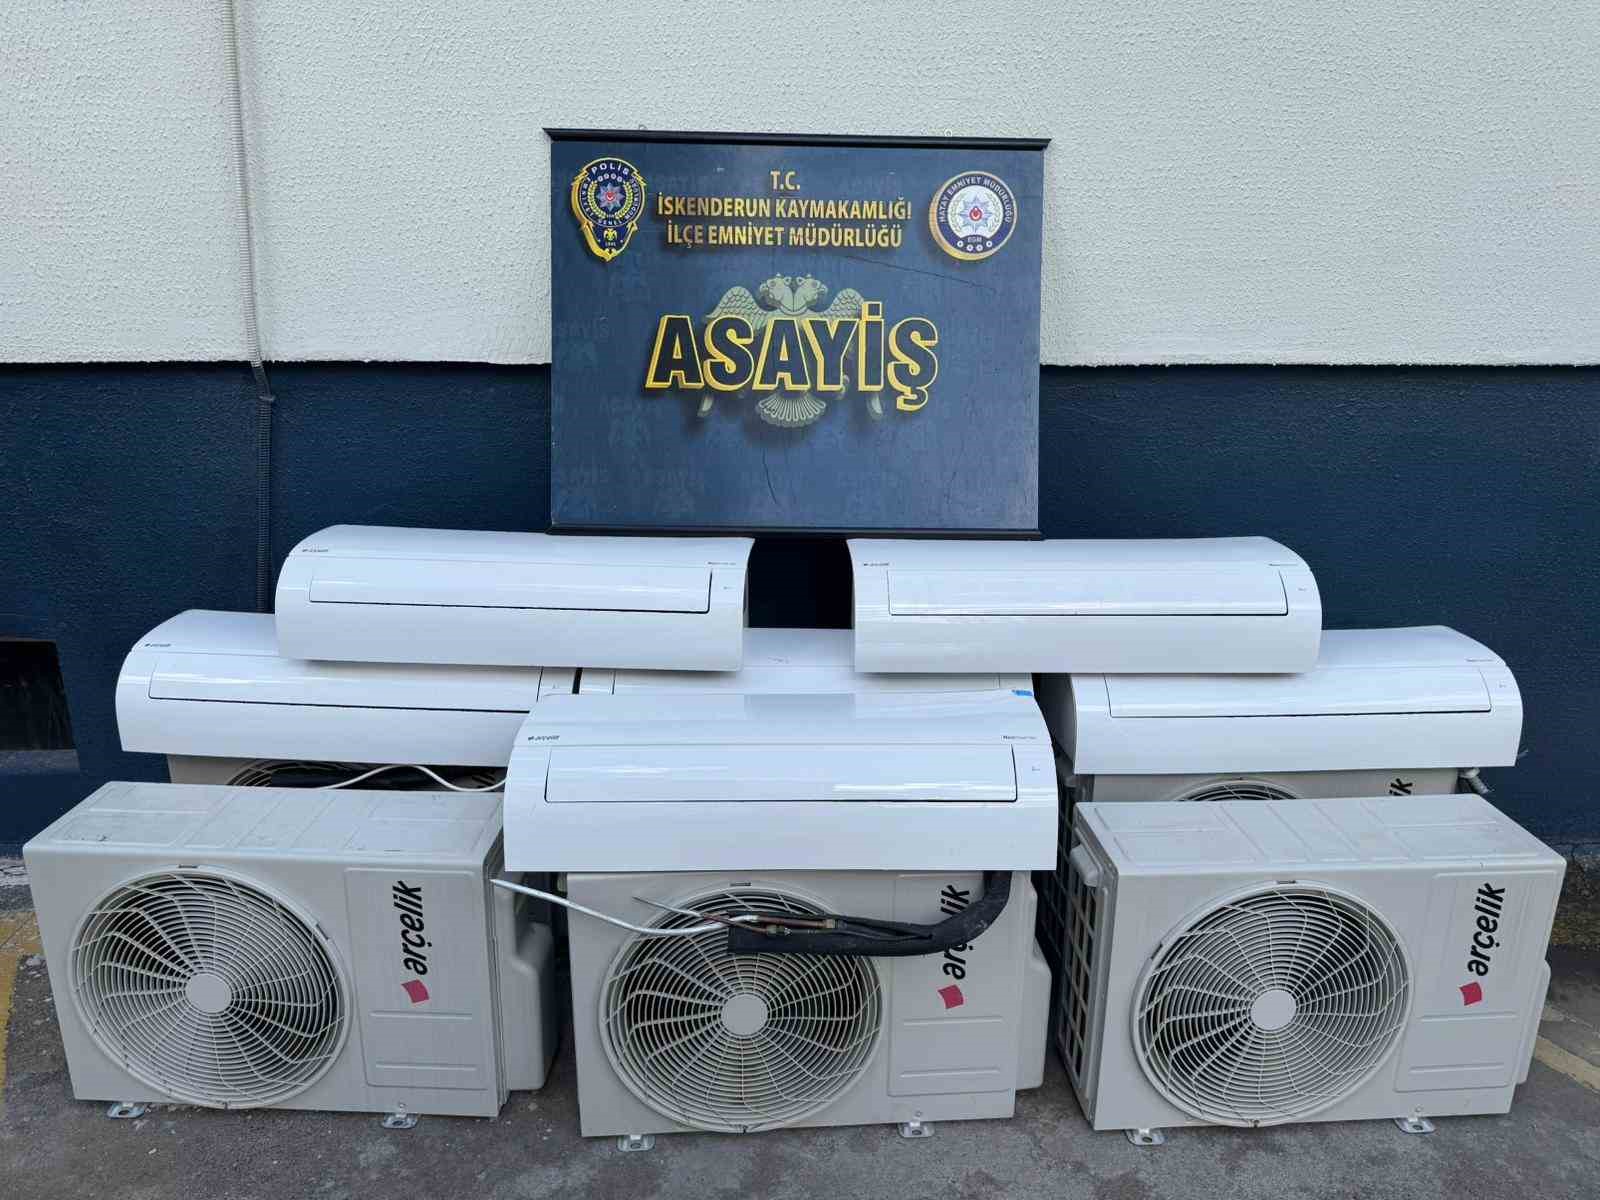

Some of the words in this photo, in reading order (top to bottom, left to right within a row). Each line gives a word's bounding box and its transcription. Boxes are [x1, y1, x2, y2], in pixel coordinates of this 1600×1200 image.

[657, 192, 771, 218] İSKENDERUN
[775, 196, 912, 220] KAYMAKAMLIĞI
[770, 170, 801, 190] T.C.
[667, 220, 703, 249] İLÇE
[708, 222, 785, 246] EMNİYET
[789, 223, 903, 248] MÜDÜRLÜĞÜ
[645, 300, 939, 412] ASAYİŞ
[392, 880, 433, 976] arçelik
[1467, 882, 1506, 977] arçelik
